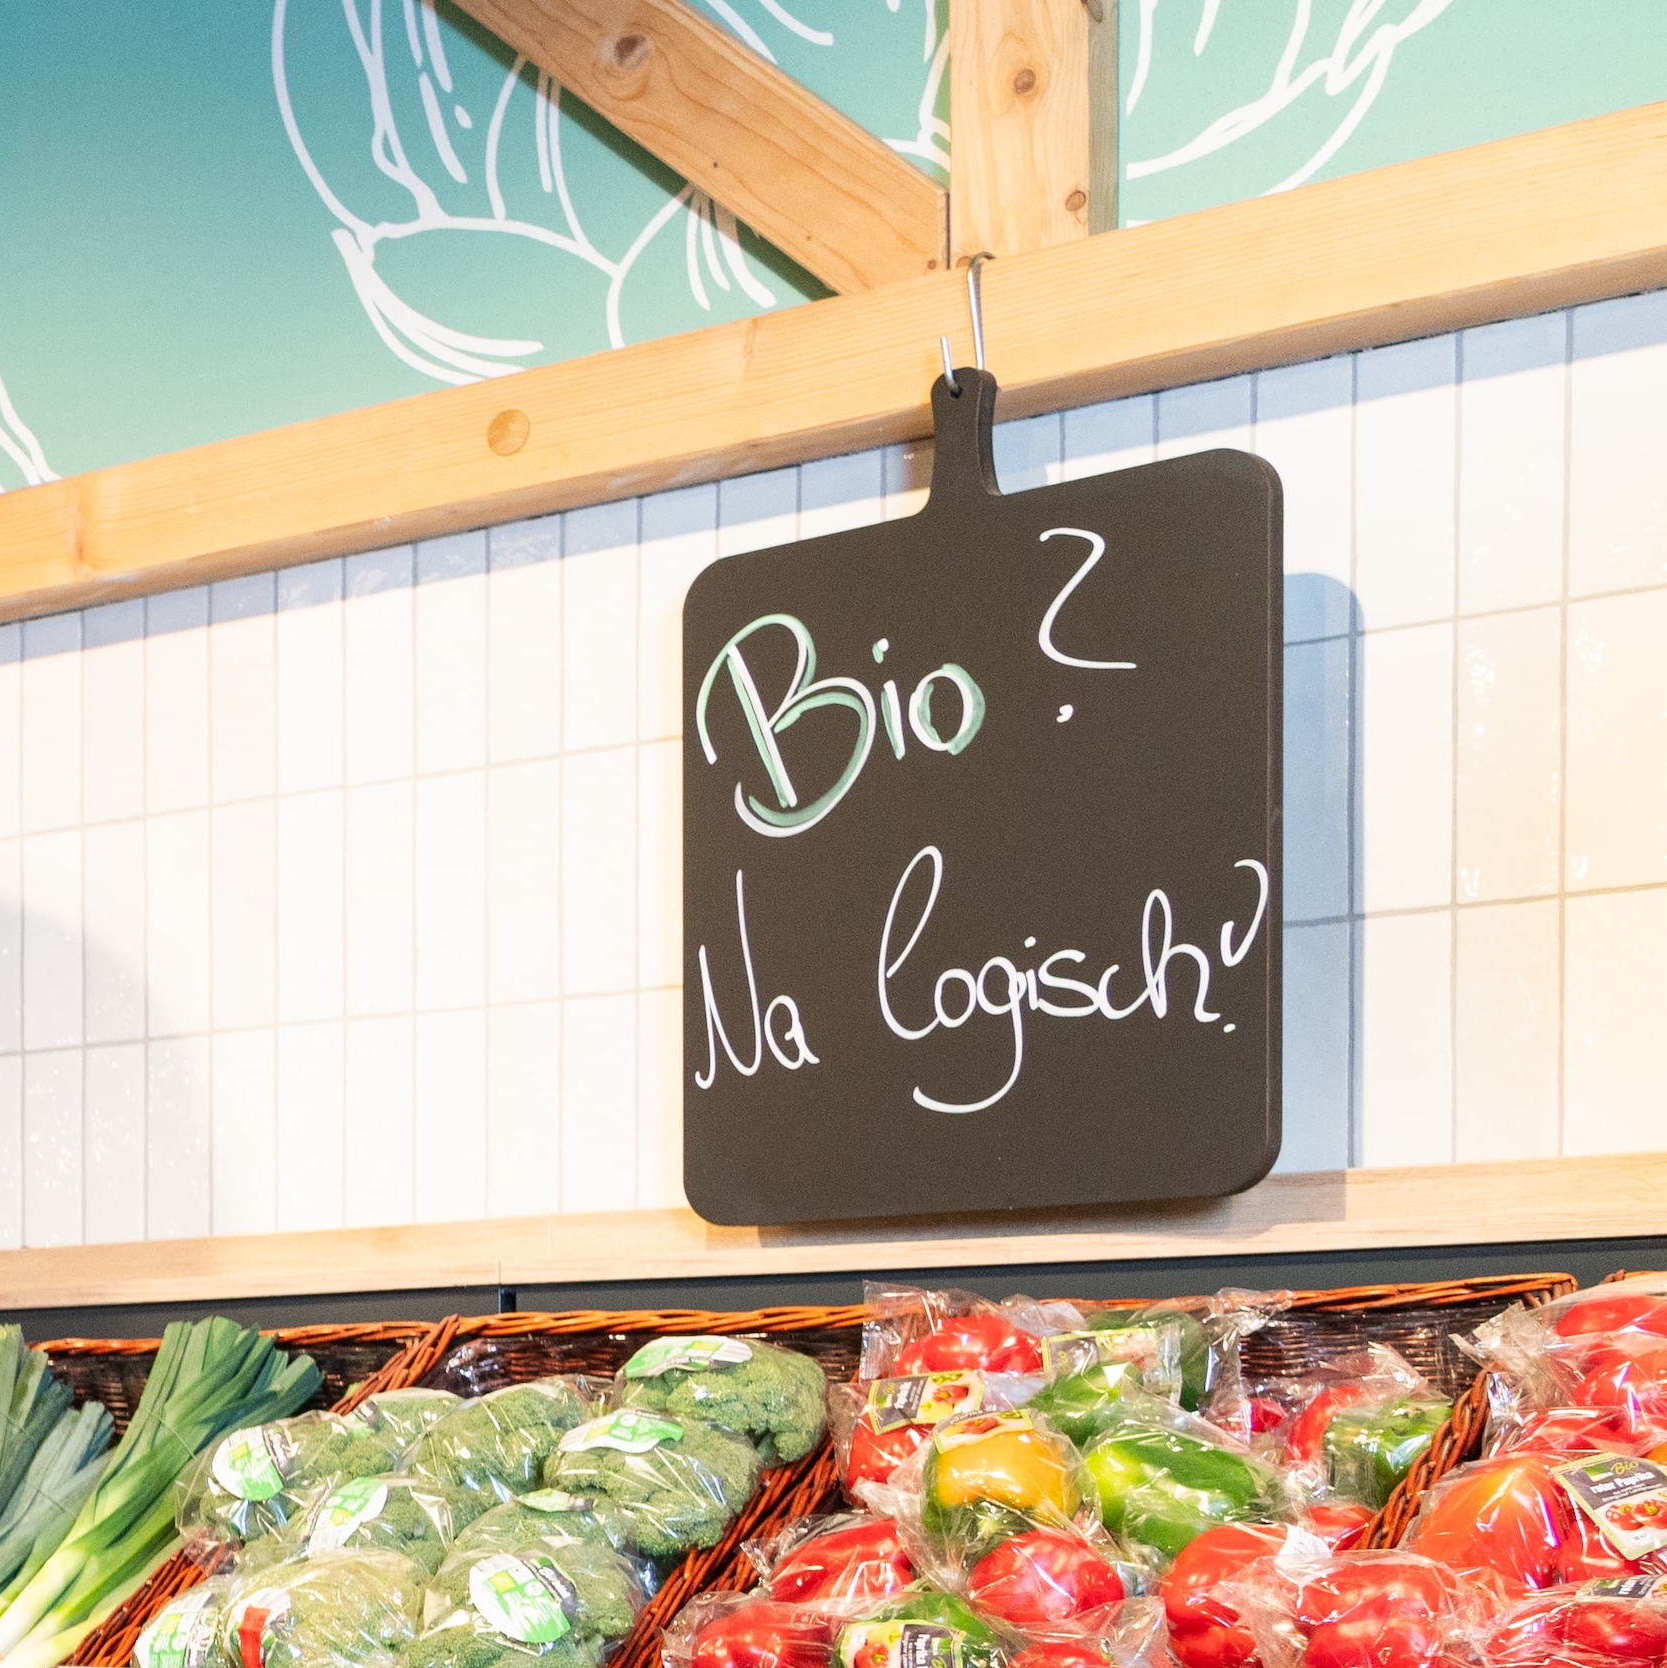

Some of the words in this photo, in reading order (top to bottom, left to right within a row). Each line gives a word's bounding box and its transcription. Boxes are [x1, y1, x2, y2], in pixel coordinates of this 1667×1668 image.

[696, 613, 985, 838] Bio
[695, 868, 821, 1089] Na
[1611, 1461, 1640, 1475] Bio
[1614, 1471, 1656, 1488] Paprika
